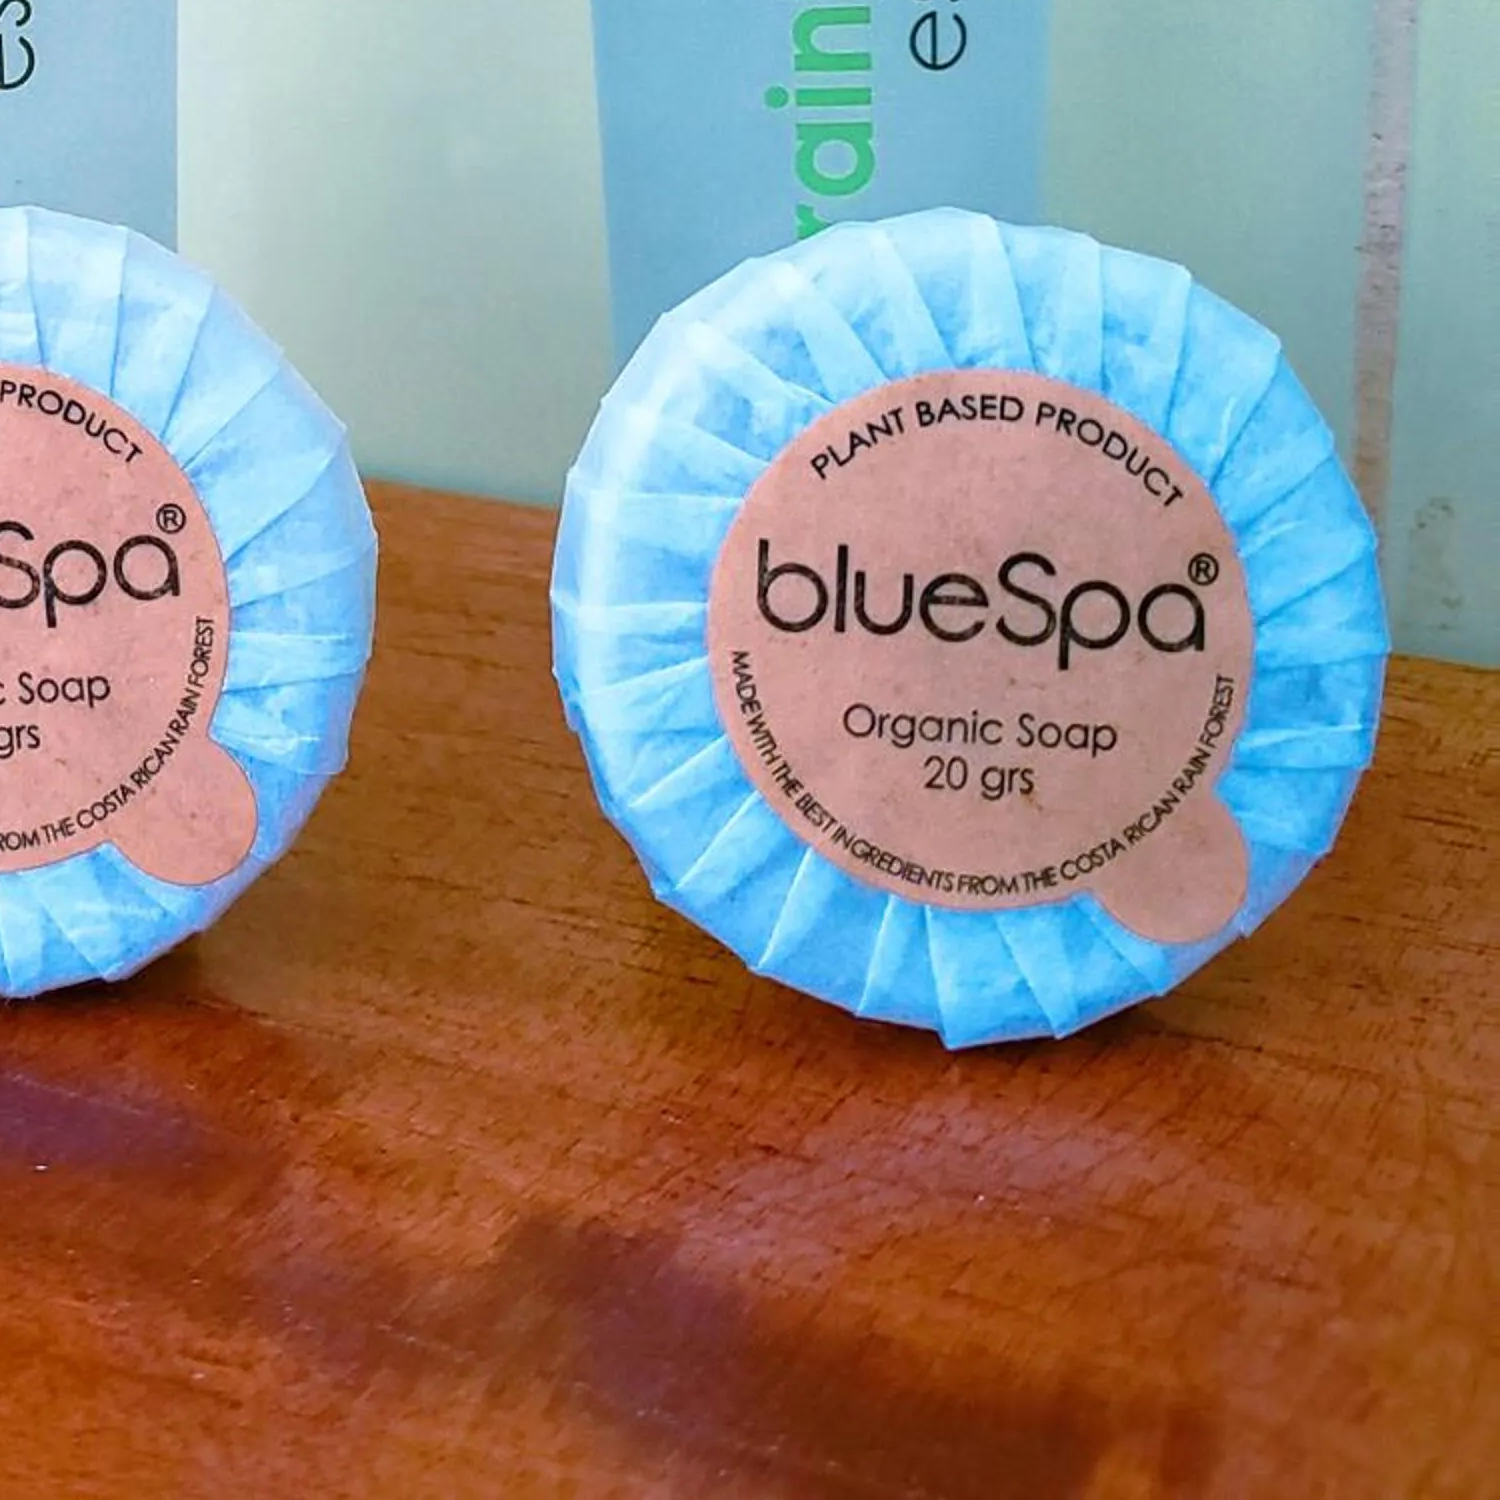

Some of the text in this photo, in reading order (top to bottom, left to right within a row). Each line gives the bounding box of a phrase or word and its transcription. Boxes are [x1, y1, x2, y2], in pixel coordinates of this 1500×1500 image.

[0, 379, 144, 465] PRODUCT
[811, 394, 1185, 508] PLANT BASED PRODUCT
[18, 671, 111, 709] Soap
[732, 650, 762, 715] MADE
[746, 711, 781, 767] WITH
[843, 703, 1118, 759] Organic Soap
[40, 816, 76, 843] THE
[76, 783, 136, 830] COSTA
[129, 733, 181, 789] RICAN
[771, 759, 805, 799] THE
[923, 755, 1035, 801] 20 grs
[794, 792, 837, 834] BEST
[1122, 790, 1181, 845] RICAN
[957, 873, 1019, 896] FROM
[1021, 865, 1059, 893] THE
[1059, 837, 1127, 882] COSTA
